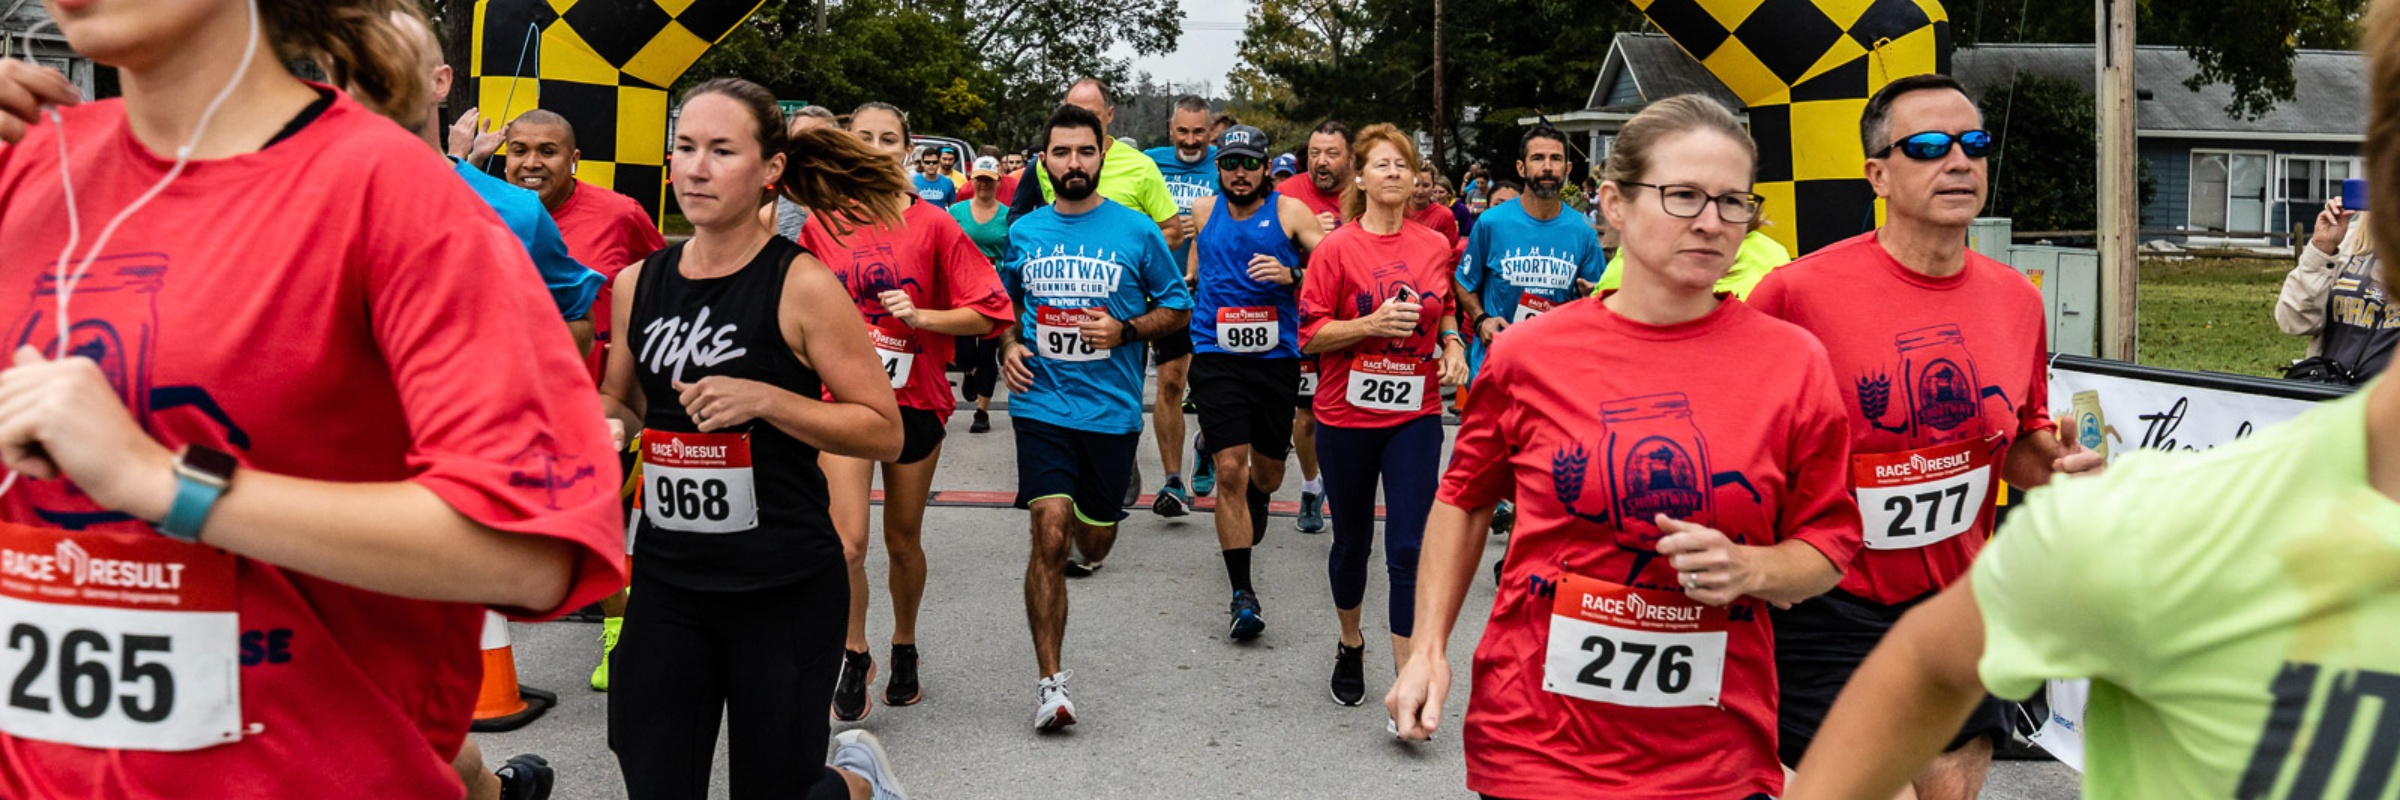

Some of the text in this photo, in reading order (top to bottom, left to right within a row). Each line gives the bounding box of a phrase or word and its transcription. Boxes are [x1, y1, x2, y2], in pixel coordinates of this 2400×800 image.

[1167, 184, 1211, 199] ORTWAY
[1025, 258, 1117, 286] SHORTWAY
[1505, 258, 1574, 279] SHORTWAY
[1036, 282, 1103, 293] RUNNING CLUB
[640, 306, 747, 388] Nike
[1228, 326, 1268, 347] 988
[1363, 361, 1416, 371] RACE RESULT
[1360, 378, 1412, 404] 262
[651, 442, 728, 458] RACE RESULT
[1876, 450, 1971, 478] RACE RESULT
[656, 475, 730, 521] 968
[1884, 482, 1969, 537] 277
[2, 549, 185, 589] RACE RESULT
[1582, 592, 1704, 622] RACE RESULT
[8, 622, 176, 724] 265
[1576, 634, 1694, 694] 276
